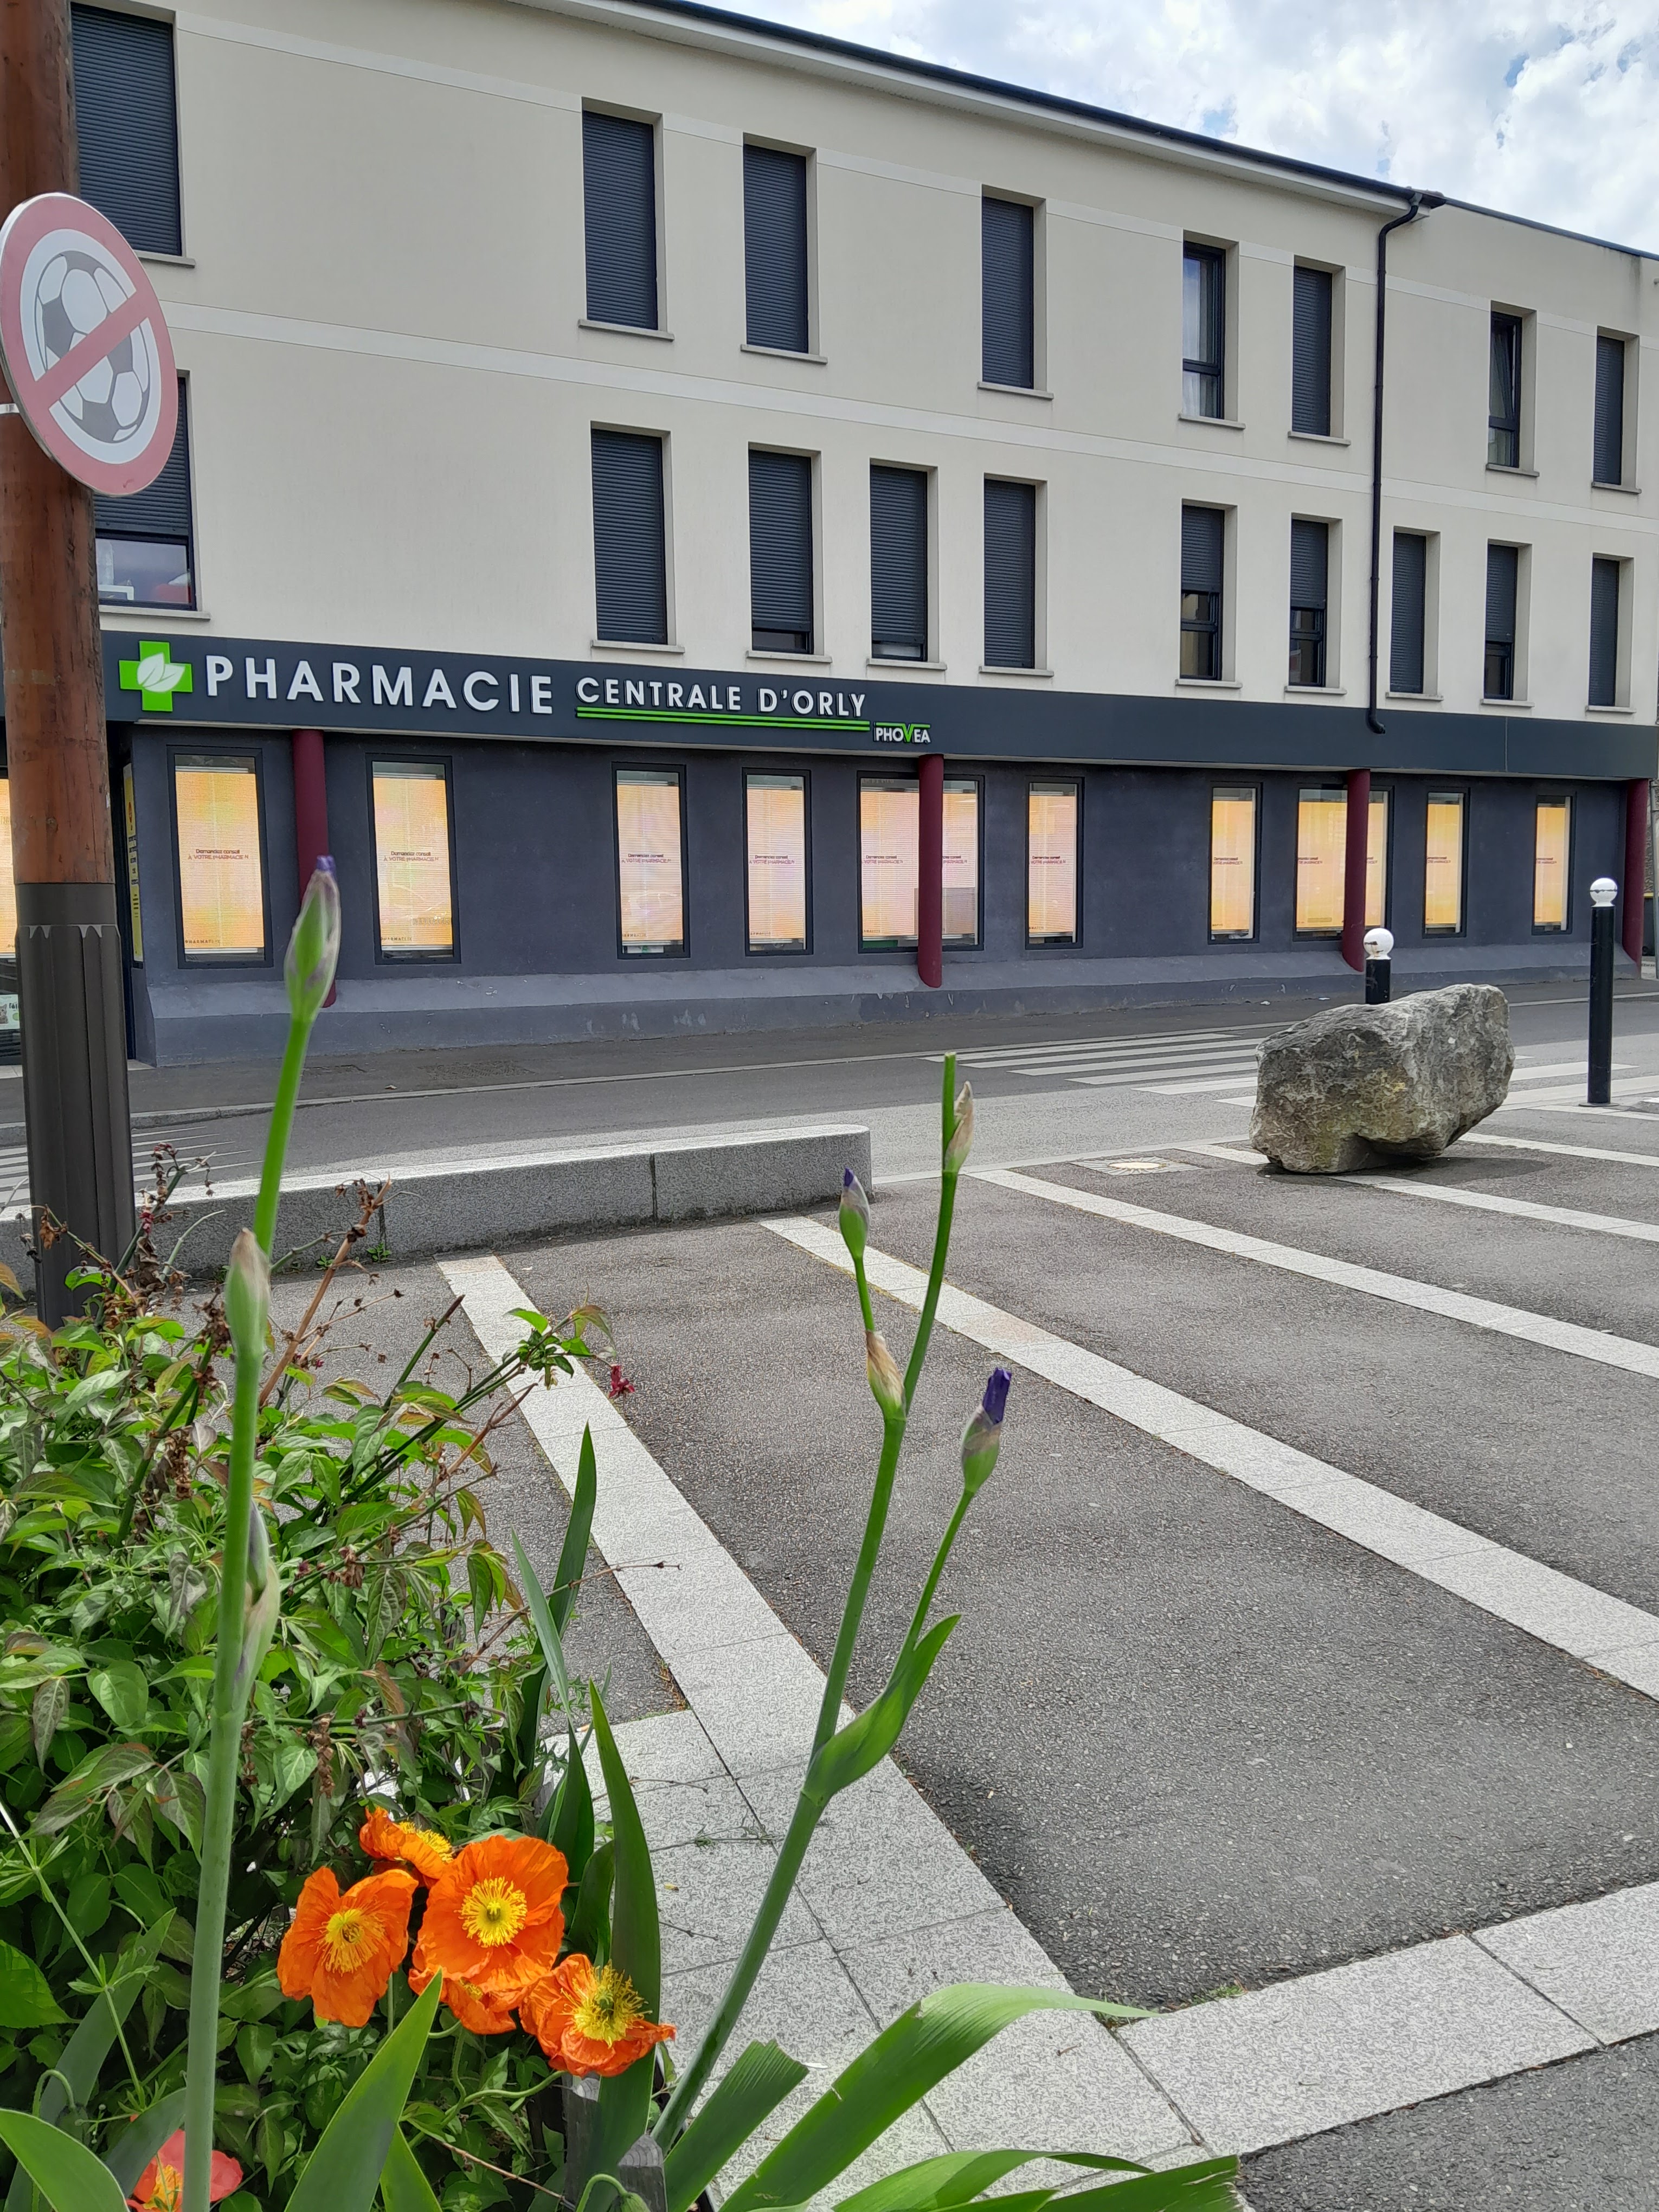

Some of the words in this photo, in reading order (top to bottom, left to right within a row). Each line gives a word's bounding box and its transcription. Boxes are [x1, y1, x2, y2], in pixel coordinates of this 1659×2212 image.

[205, 654, 552, 715] PHARMACIE
[576, 676, 741, 711] CENTRALE
[758, 687, 865, 718] D'ORLY
[873, 722, 931, 743] PHOVEA
